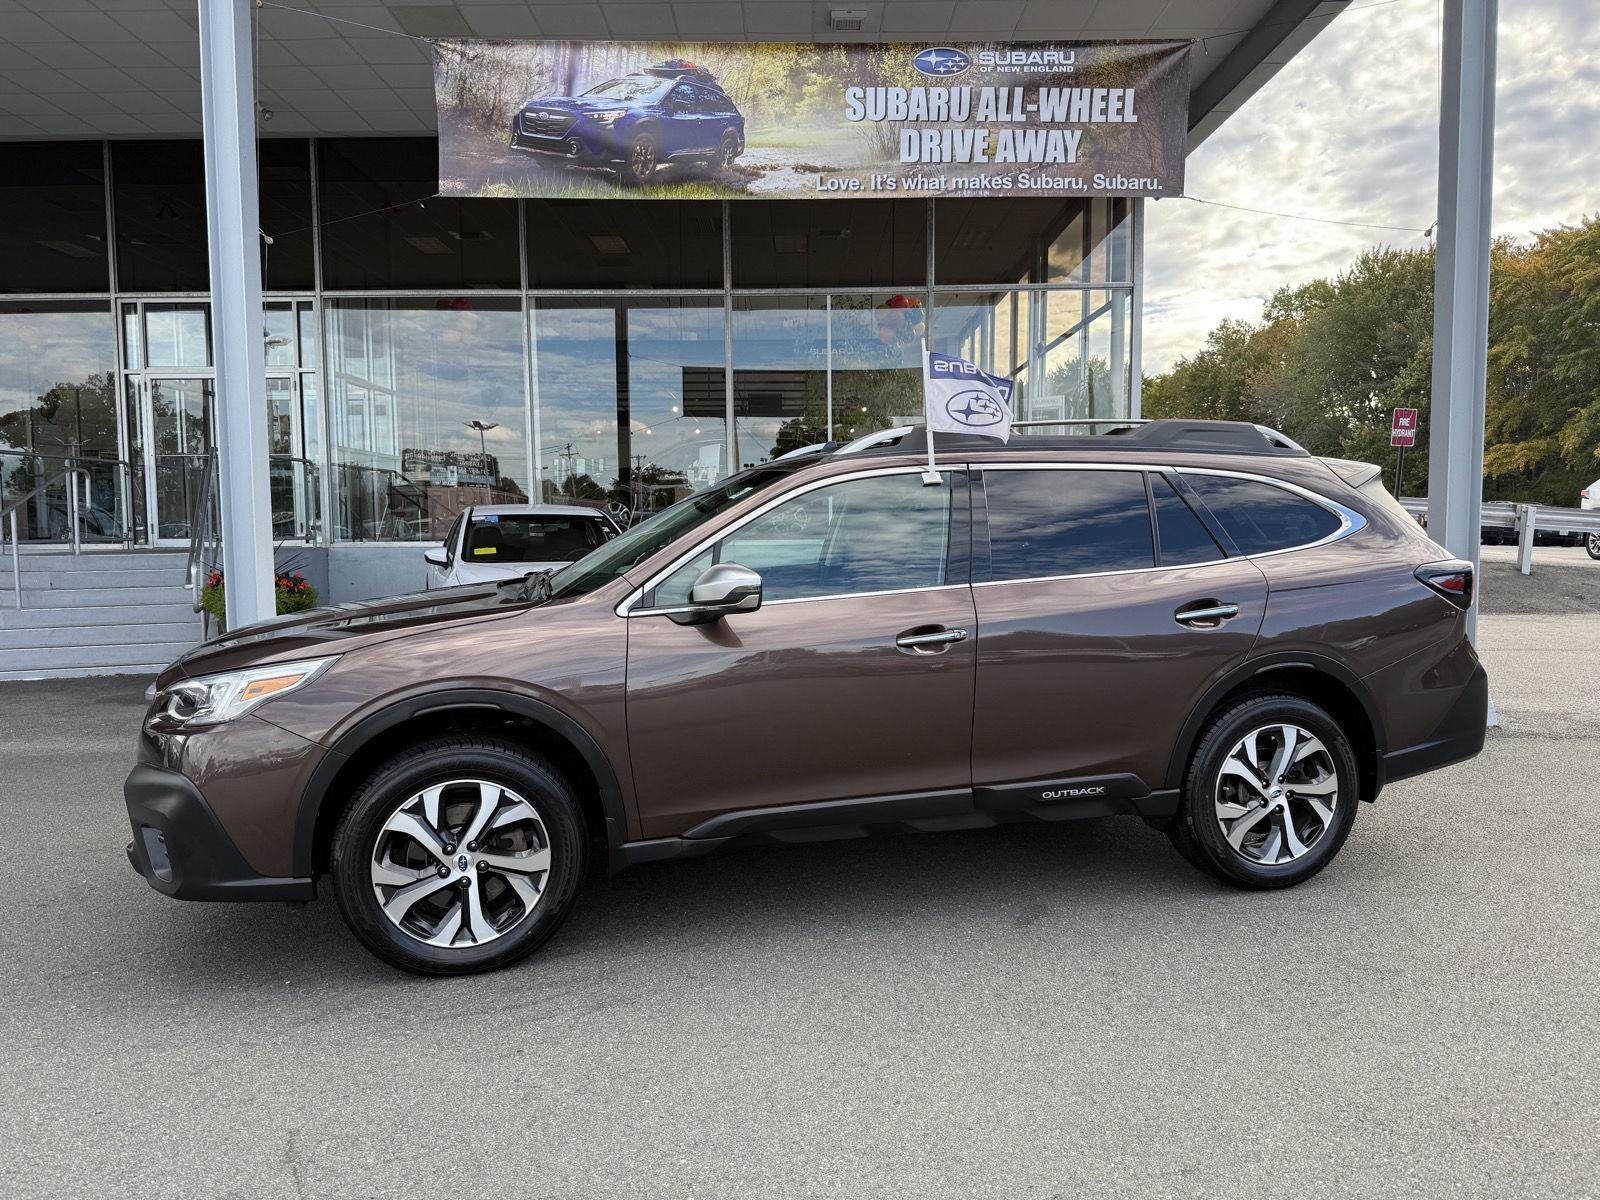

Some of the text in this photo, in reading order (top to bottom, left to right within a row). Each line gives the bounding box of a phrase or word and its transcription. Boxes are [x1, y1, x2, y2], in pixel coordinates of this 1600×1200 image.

[979, 51, 1075, 65] SUBARU
[980, 65, 1074, 73] OF NEW ENGLAND
[845, 86, 1138, 123] SUBARU ALL-WHEEL
[900, 128, 1083, 163] DRIVE AWAY
[816, 173, 1163, 192] Love. It's what makes Subaru, Subaru.
[1399, 417, 1410, 426] FIRE
[1392, 428, 1415, 437] HYDRANT
[1042, 786, 1105, 798] OUTBACK
